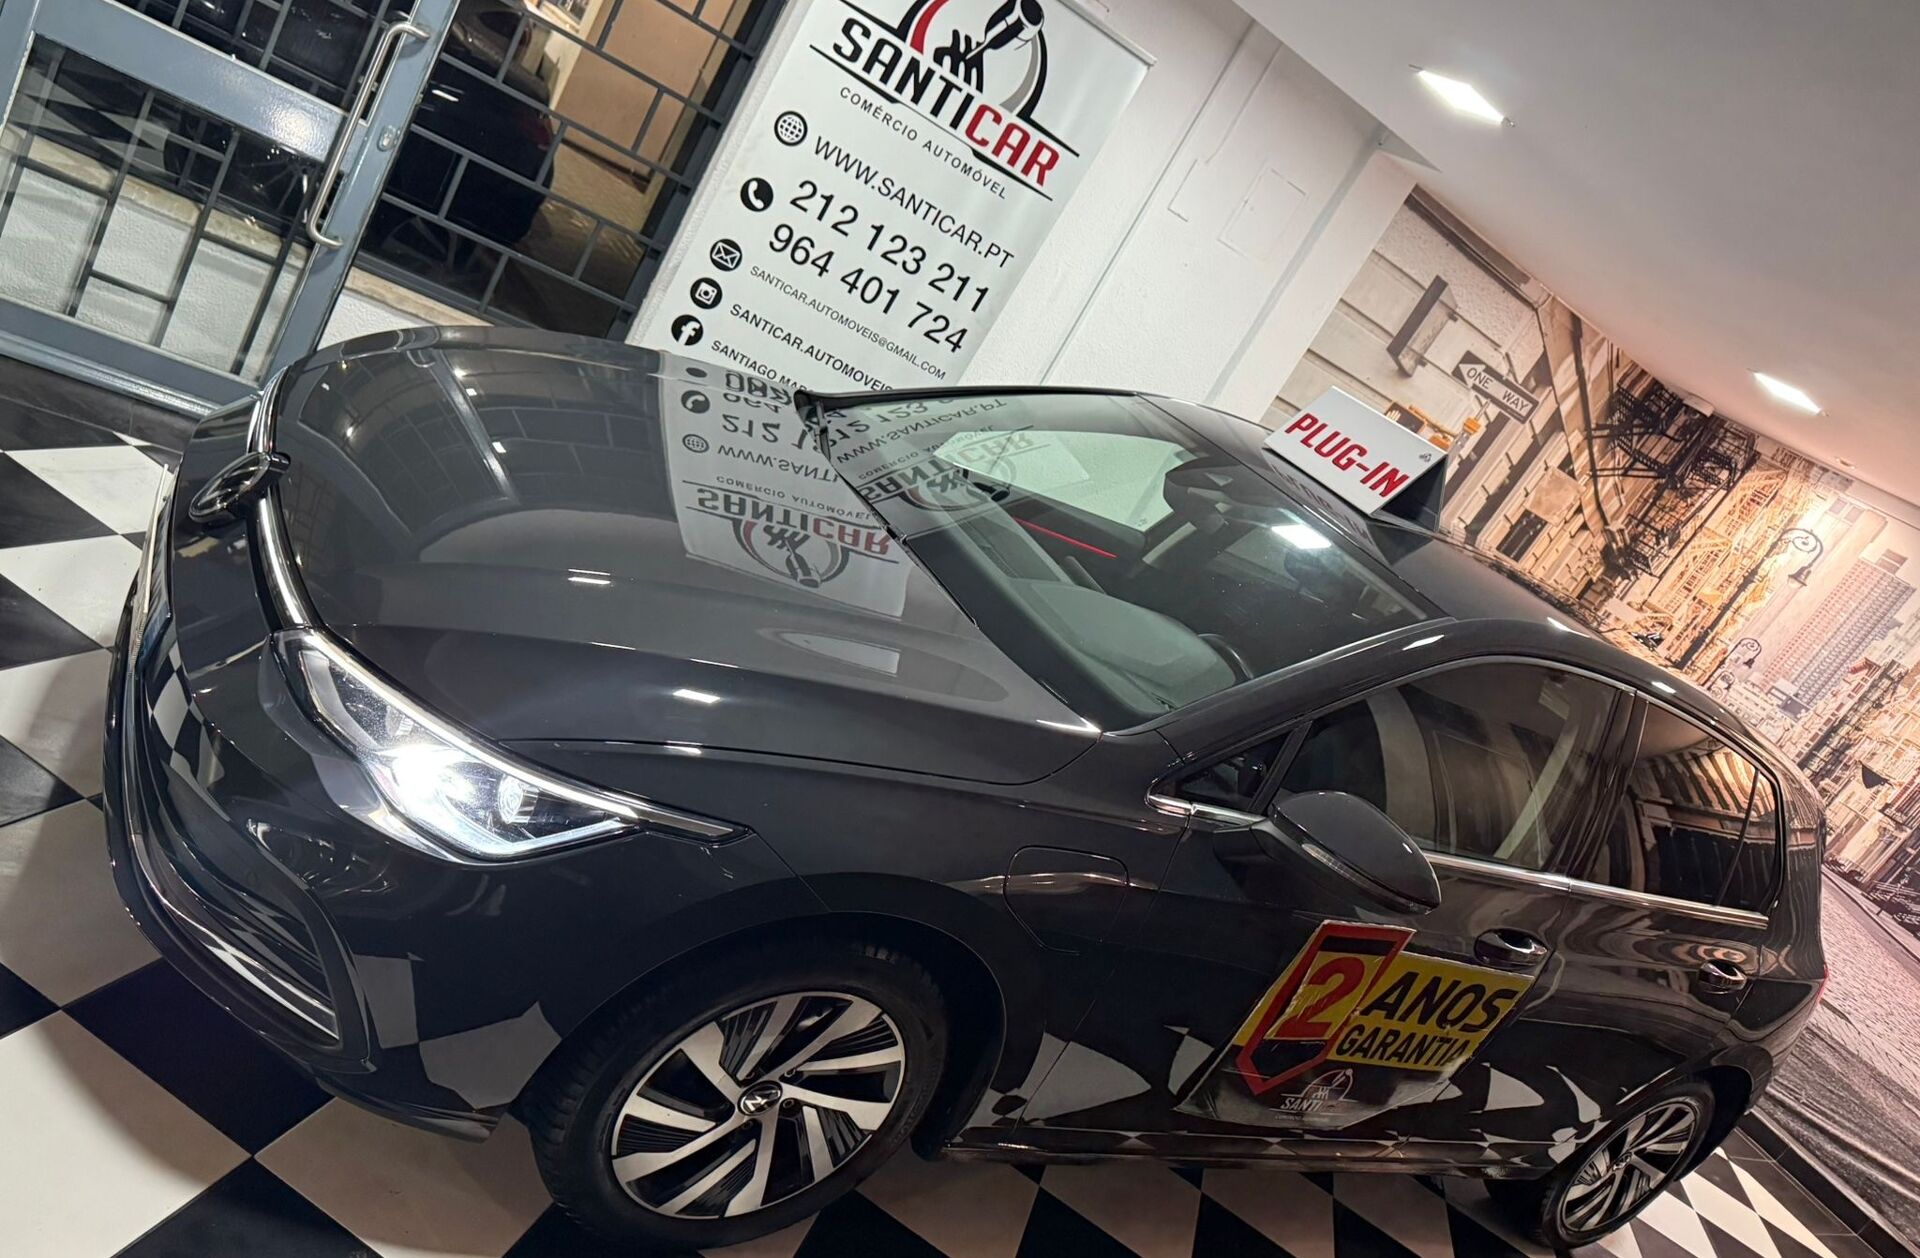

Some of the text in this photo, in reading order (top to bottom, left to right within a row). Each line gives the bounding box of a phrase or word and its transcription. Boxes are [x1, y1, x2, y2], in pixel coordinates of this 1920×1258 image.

[833, 17, 1060, 188] SANTICAR
[840, 86, 1008, 200] COMÉRCIO AUTOMÓVEL
[789, 179, 990, 313] 212 123 211
[814, 136, 1015, 269] WWW.SANTICAR.PT
[749, 265, 947, 380] SANTICAR.AUTOMOVEIS@GMAIL.COM
[768, 223, 968, 354] 964 401 724
[711, 340, 777, 380] SANTIAGO
[1465, 366, 1530, 413] ONE WAY
[1284, 412, 1410, 498] PLUG-IN
[1273, 956, 1521, 1039] 2 ANOS
